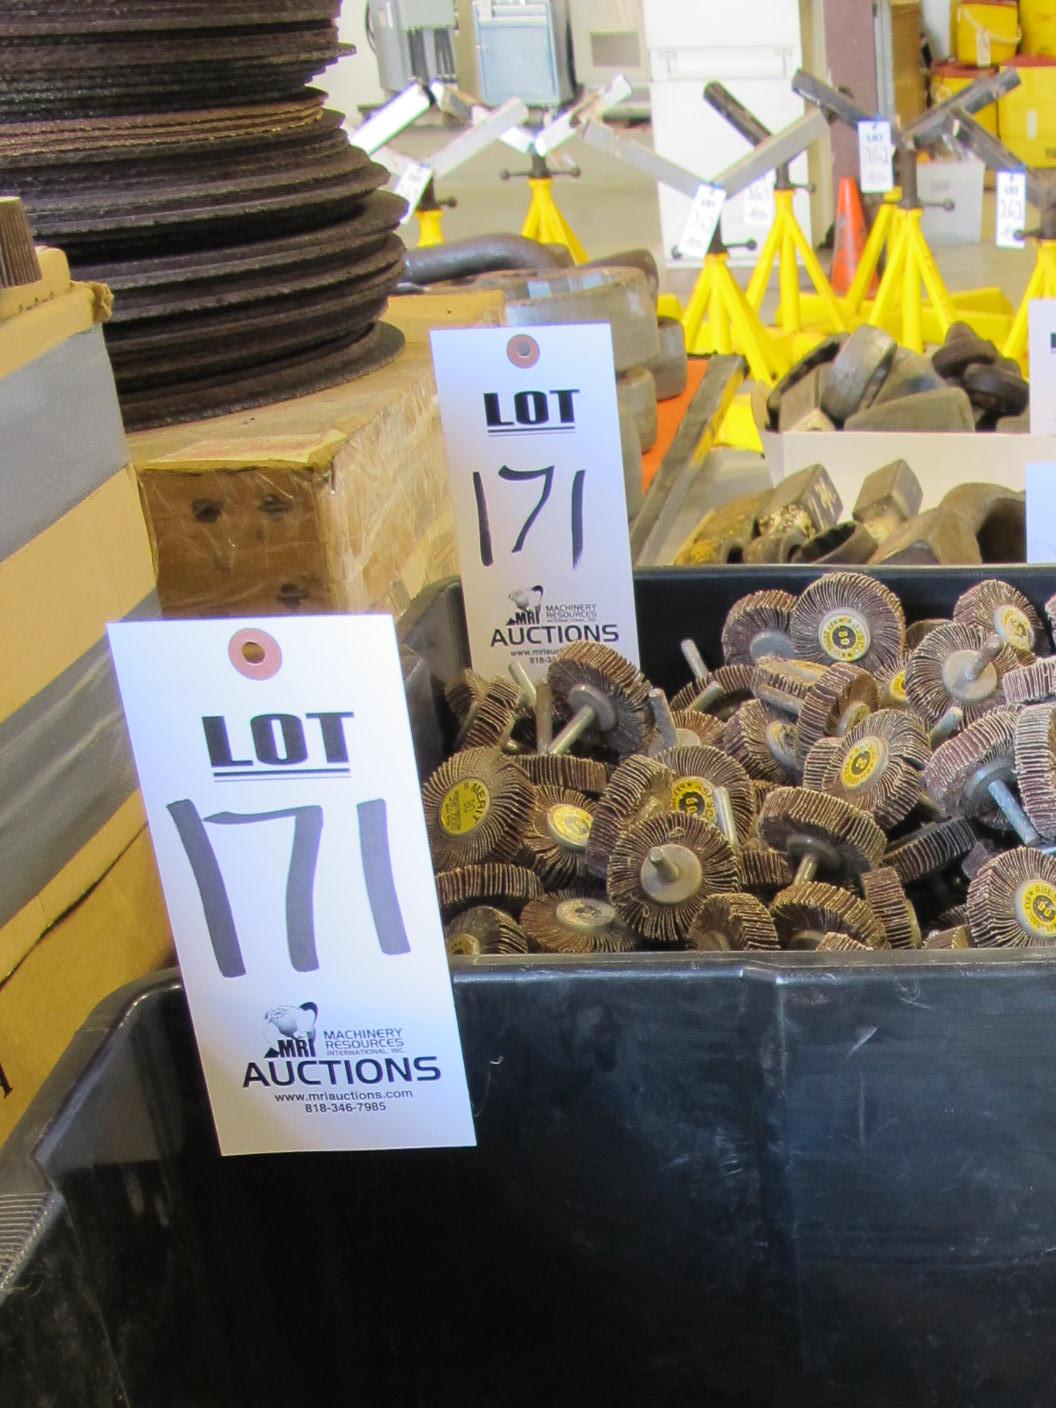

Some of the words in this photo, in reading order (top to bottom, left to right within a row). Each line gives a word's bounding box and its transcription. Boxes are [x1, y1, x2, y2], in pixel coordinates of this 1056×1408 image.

[483, 389, 580, 427] LOT
[472, 465, 586, 569] 171
[515, 609, 541, 625] MRI
[545, 604, 597, 612] MACHINERY
[546, 611, 597, 619] RESOURCES
[490, 624, 619, 647] AUCTIONS
[202, 711, 354, 768] LOT
[470, 783, 486, 824] MERIT
[166, 798, 412, 978] 171
[323, 1028, 403, 1041] MACHINERY
[325, 1038, 404, 1050] RESOURCES
[277, 1036, 316, 1058] MRI
[242, 1056, 441, 1088] AUCTIONS
[274, 1090, 413, 1102] www.mriauctions.com
[305, 1102, 387, 1114] 818-346-7985
